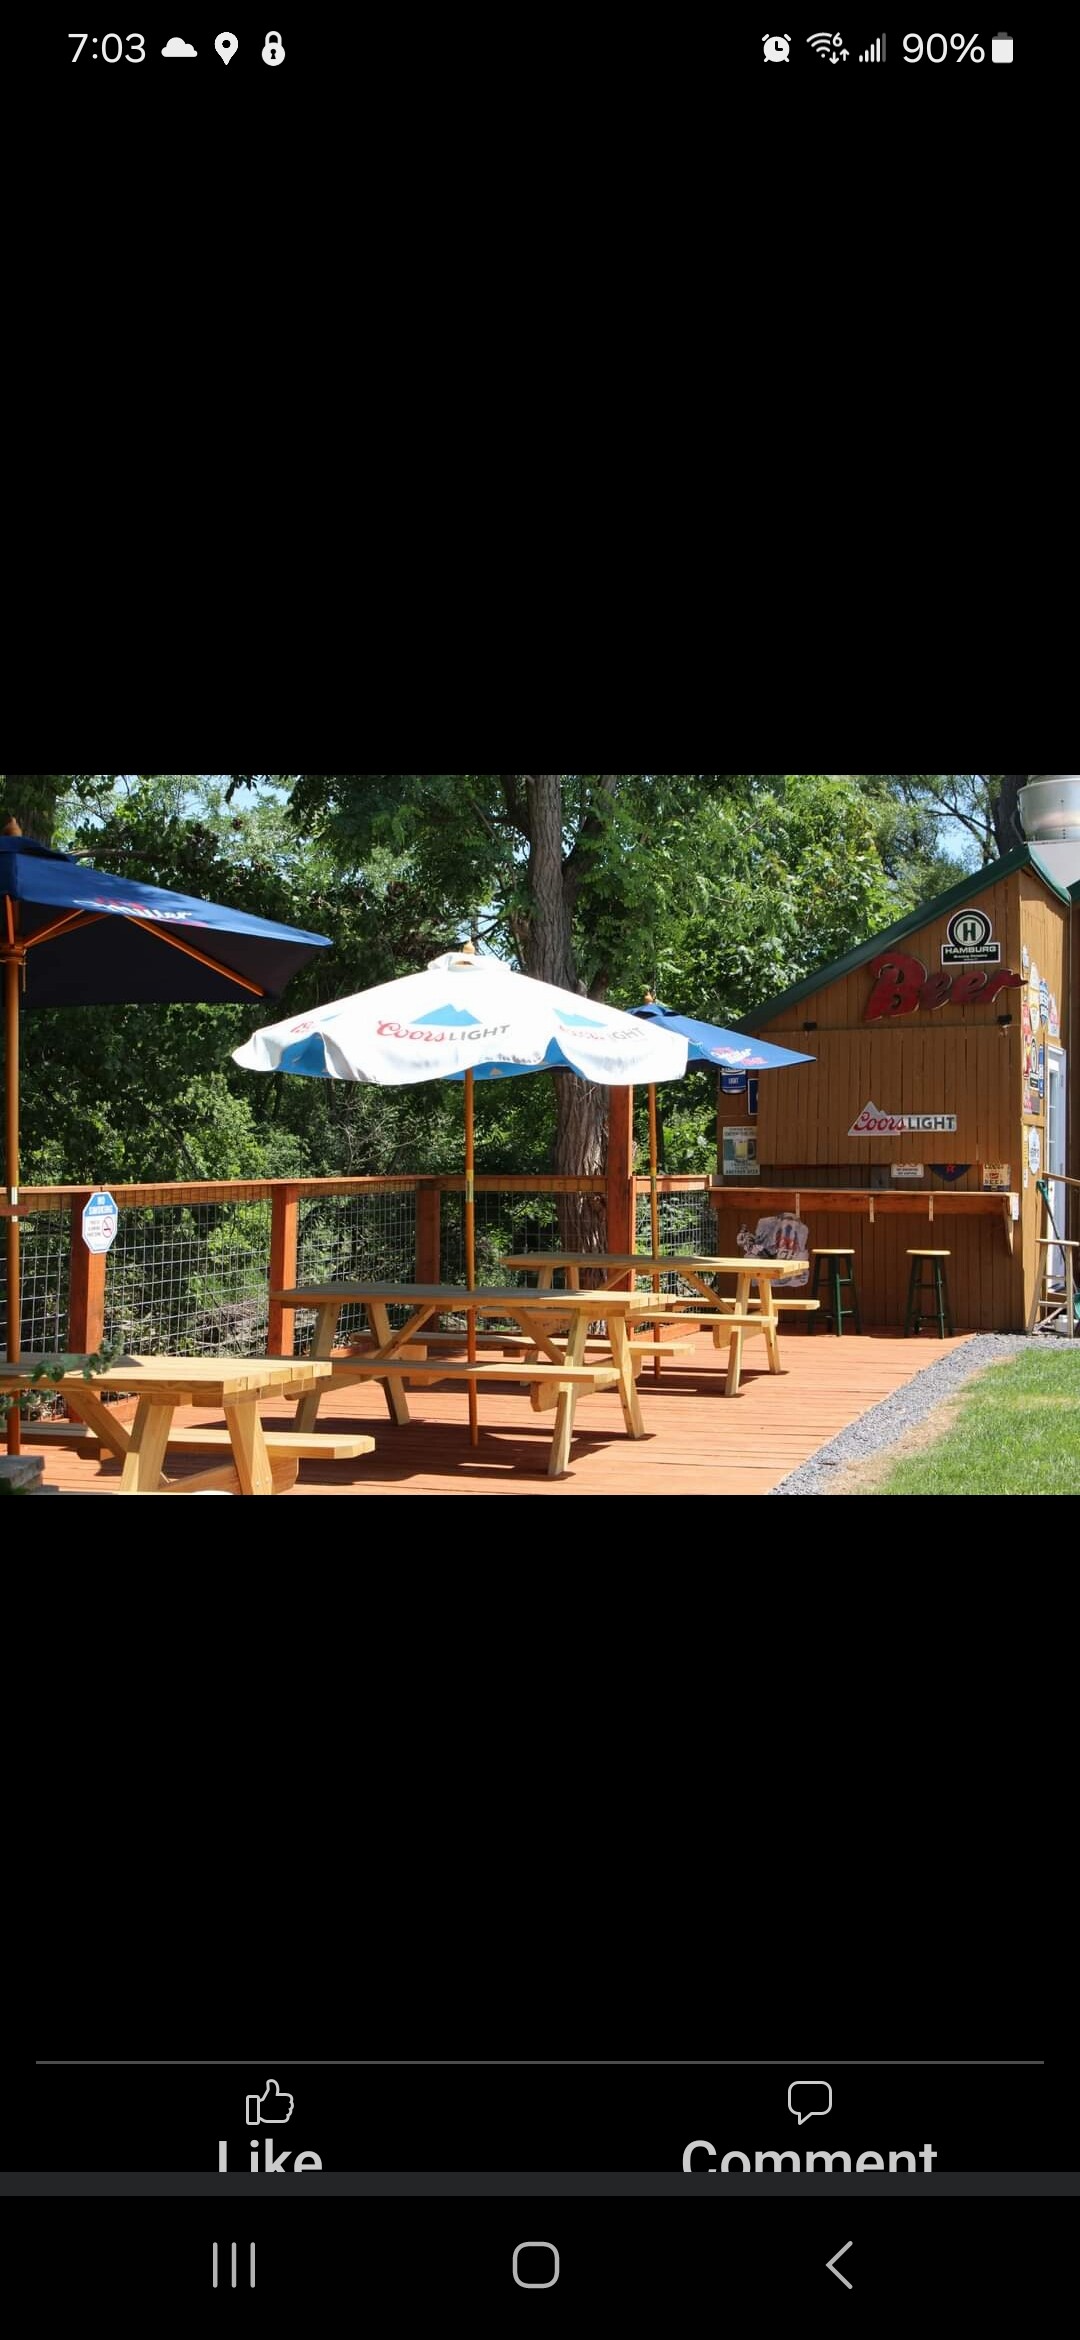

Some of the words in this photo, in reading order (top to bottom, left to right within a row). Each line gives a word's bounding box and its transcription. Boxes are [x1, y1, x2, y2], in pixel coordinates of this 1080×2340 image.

[962, 922, 977, 942] H
[944, 945, 997, 955] HAMBURG
[864, 952, 1029, 1022] Beer
[376, 1020, 446, 1043] Coors
[448, 1024, 511, 1041] LIGHT
[853, 1111, 907, 1131] Coors
[908, 1116, 955, 1130] LIGHT
